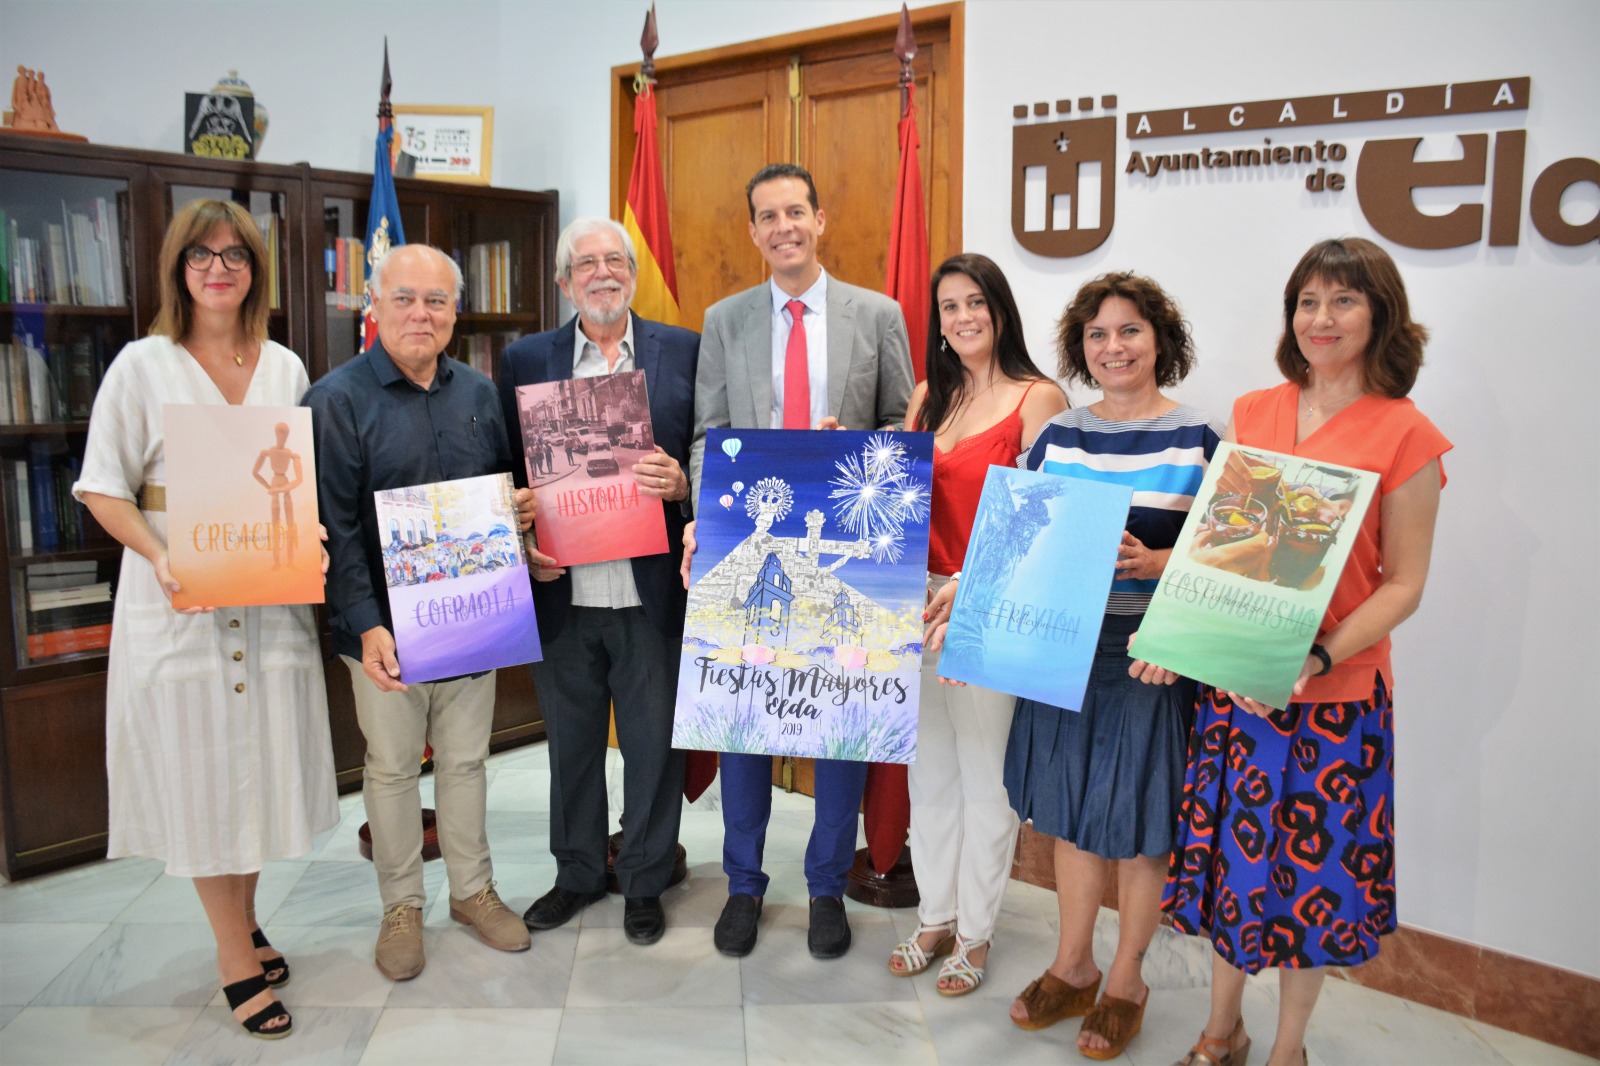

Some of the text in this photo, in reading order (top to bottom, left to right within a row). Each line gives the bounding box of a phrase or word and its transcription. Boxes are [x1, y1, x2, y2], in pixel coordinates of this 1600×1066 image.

[1136, 82, 1515, 134] ALCALDÍA
[1125, 137, 1347, 177] Ayuntamiento
[1305, 168, 1345, 192] de
[557, 482, 640, 517] HISTORIA
[413, 585, 516, 628] COFRADÍA
[694, 656, 909, 706] Fiestas Mayores
[781, 723, 803, 736] 2019
